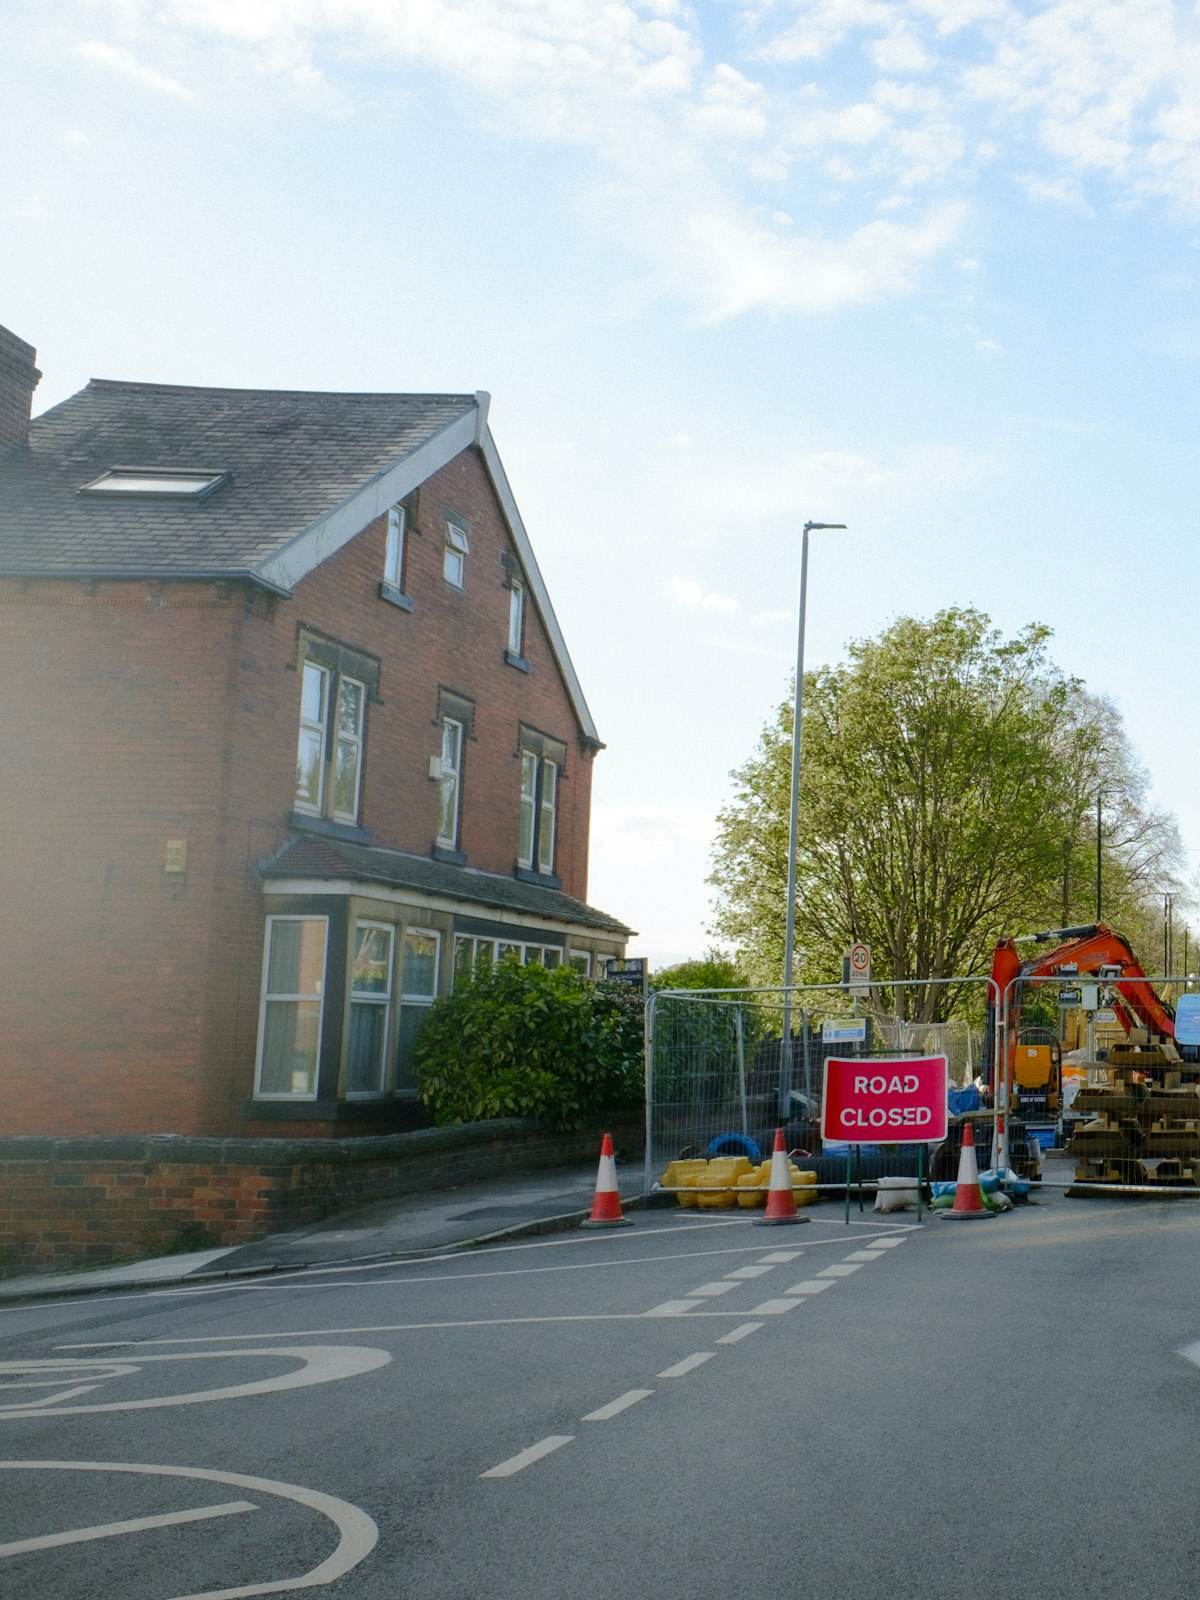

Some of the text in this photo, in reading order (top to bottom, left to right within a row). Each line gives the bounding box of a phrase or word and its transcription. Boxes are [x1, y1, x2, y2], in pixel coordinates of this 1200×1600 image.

[854, 952, 866, 962] 20
[854, 1075, 919, 1095] ROAD
[840, 1106, 932, 1127] CLOSED
